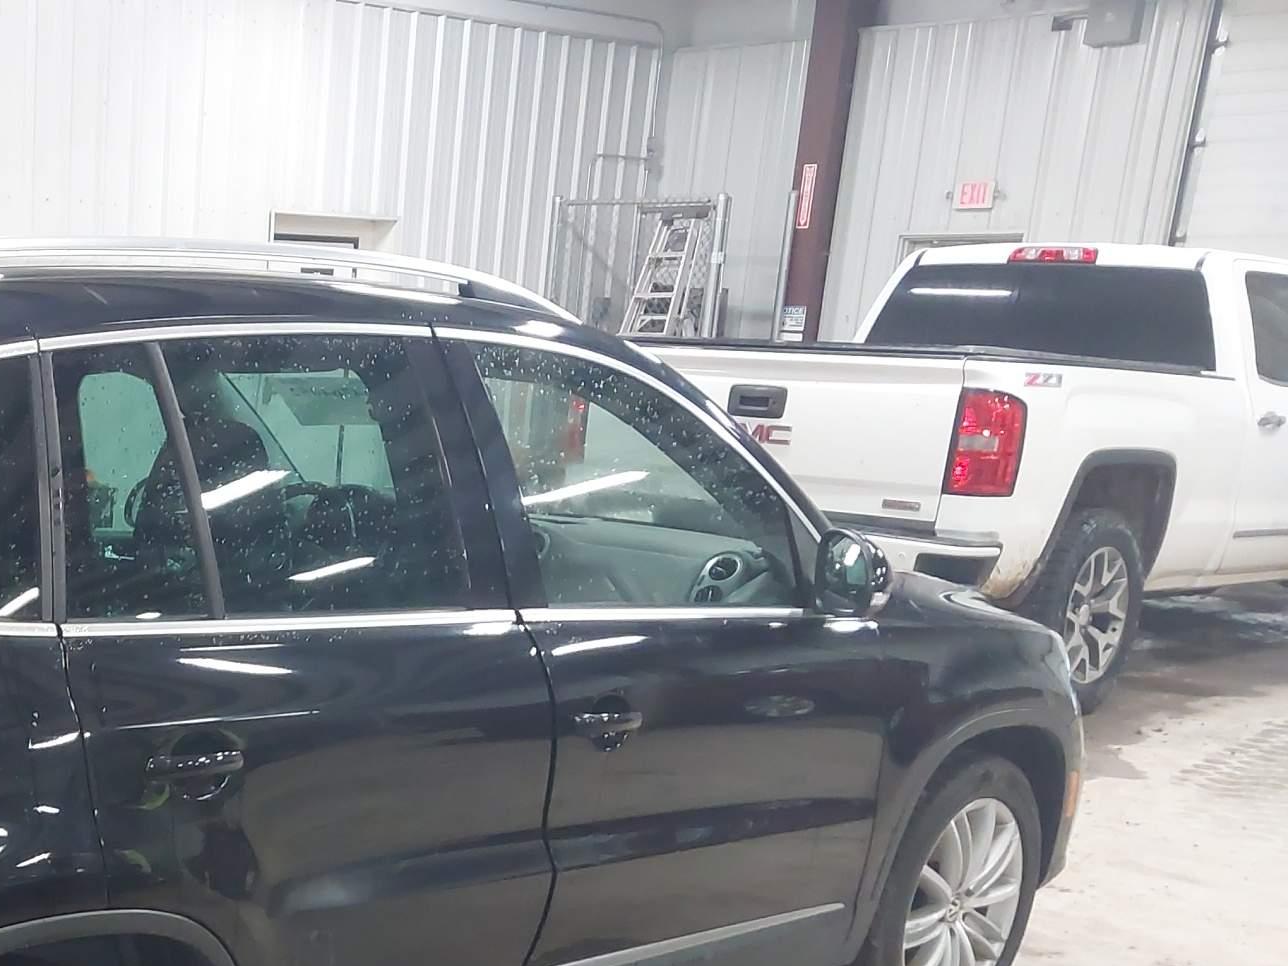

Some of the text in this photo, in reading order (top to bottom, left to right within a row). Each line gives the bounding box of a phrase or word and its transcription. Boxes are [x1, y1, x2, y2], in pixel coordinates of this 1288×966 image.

[960, 183, 987, 204] EXIT
[1024, 372, 1063, 388] Z71
[735, 421, 793, 446] MC
